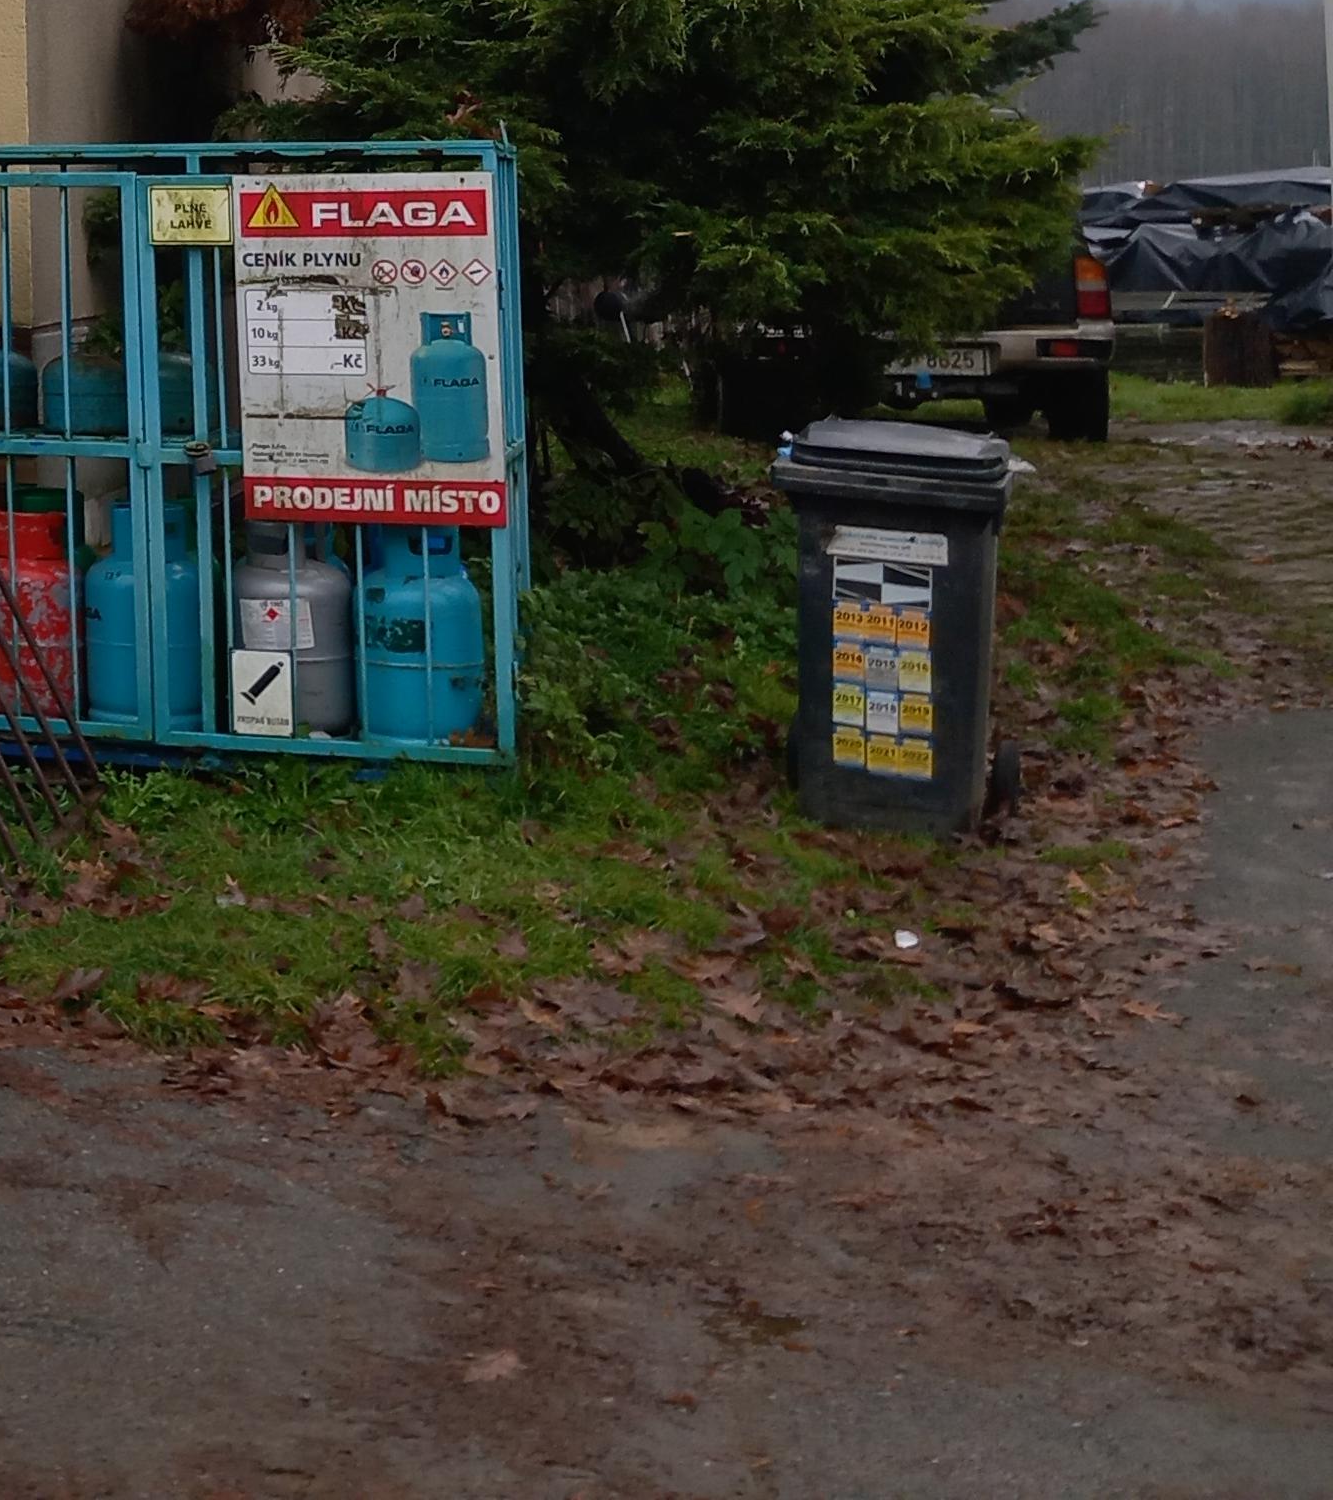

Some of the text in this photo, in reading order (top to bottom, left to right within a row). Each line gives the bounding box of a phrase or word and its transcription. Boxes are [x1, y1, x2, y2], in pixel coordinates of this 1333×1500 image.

[312, 201, 477, 228] FLAGA
[242, 251, 361, 267] CENÍK PLYNU
[256, 300, 263, 311] 2
[266, 302, 278, 313] kg
[251, 328, 265, 338] 10
[267, 330, 279, 340] kg
[251, 356, 266, 366] 33
[268, 358, 280, 369] kg
[433, 377, 479, 388] FLAGA
[365, 424, 415, 434] FLAGA
[253, 484, 501, 514] PRODEJNÍ MÍSTO
[866, 614, 896, 627] 2011
[899, 619, 928, 632] 2012
[835, 693, 862, 706] 2017
[869, 746, 896, 758] 2021
